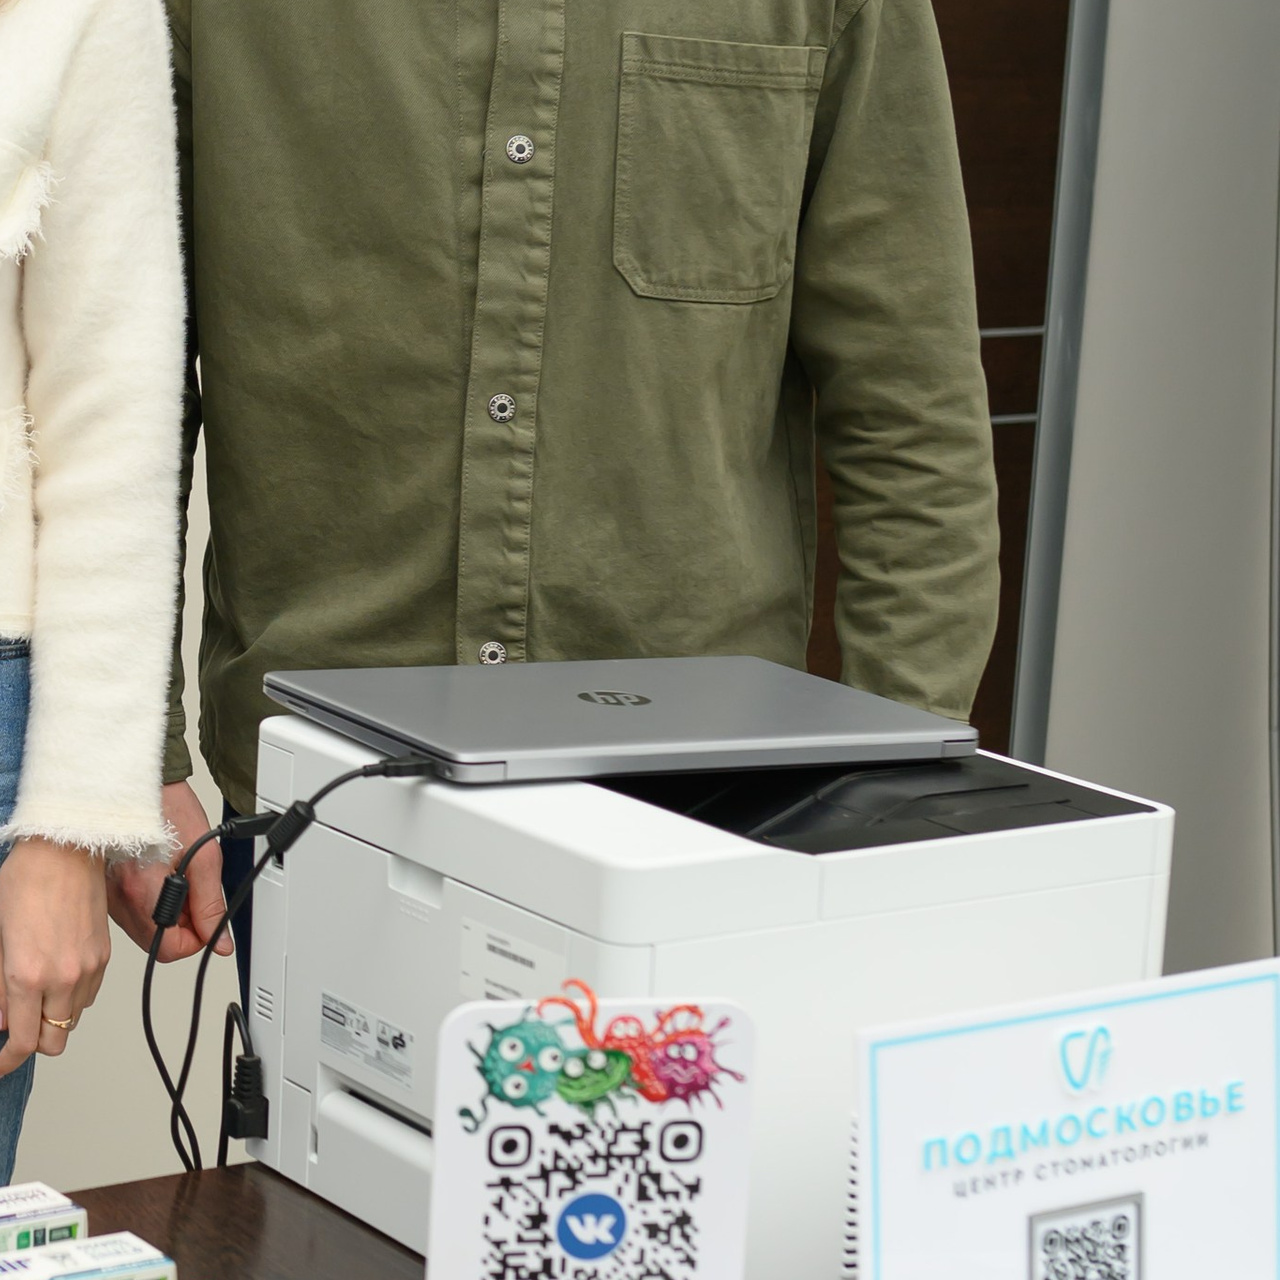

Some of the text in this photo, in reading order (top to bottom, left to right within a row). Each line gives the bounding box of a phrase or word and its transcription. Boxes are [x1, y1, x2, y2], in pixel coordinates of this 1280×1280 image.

[580, 688, 648, 707] hp
[922, 1080, 1246, 1171] ПОДМОСКОВЬЕ
[952, 1131, 1210, 1198] ЦЕНТР СТОМАТОЛОГИИ
